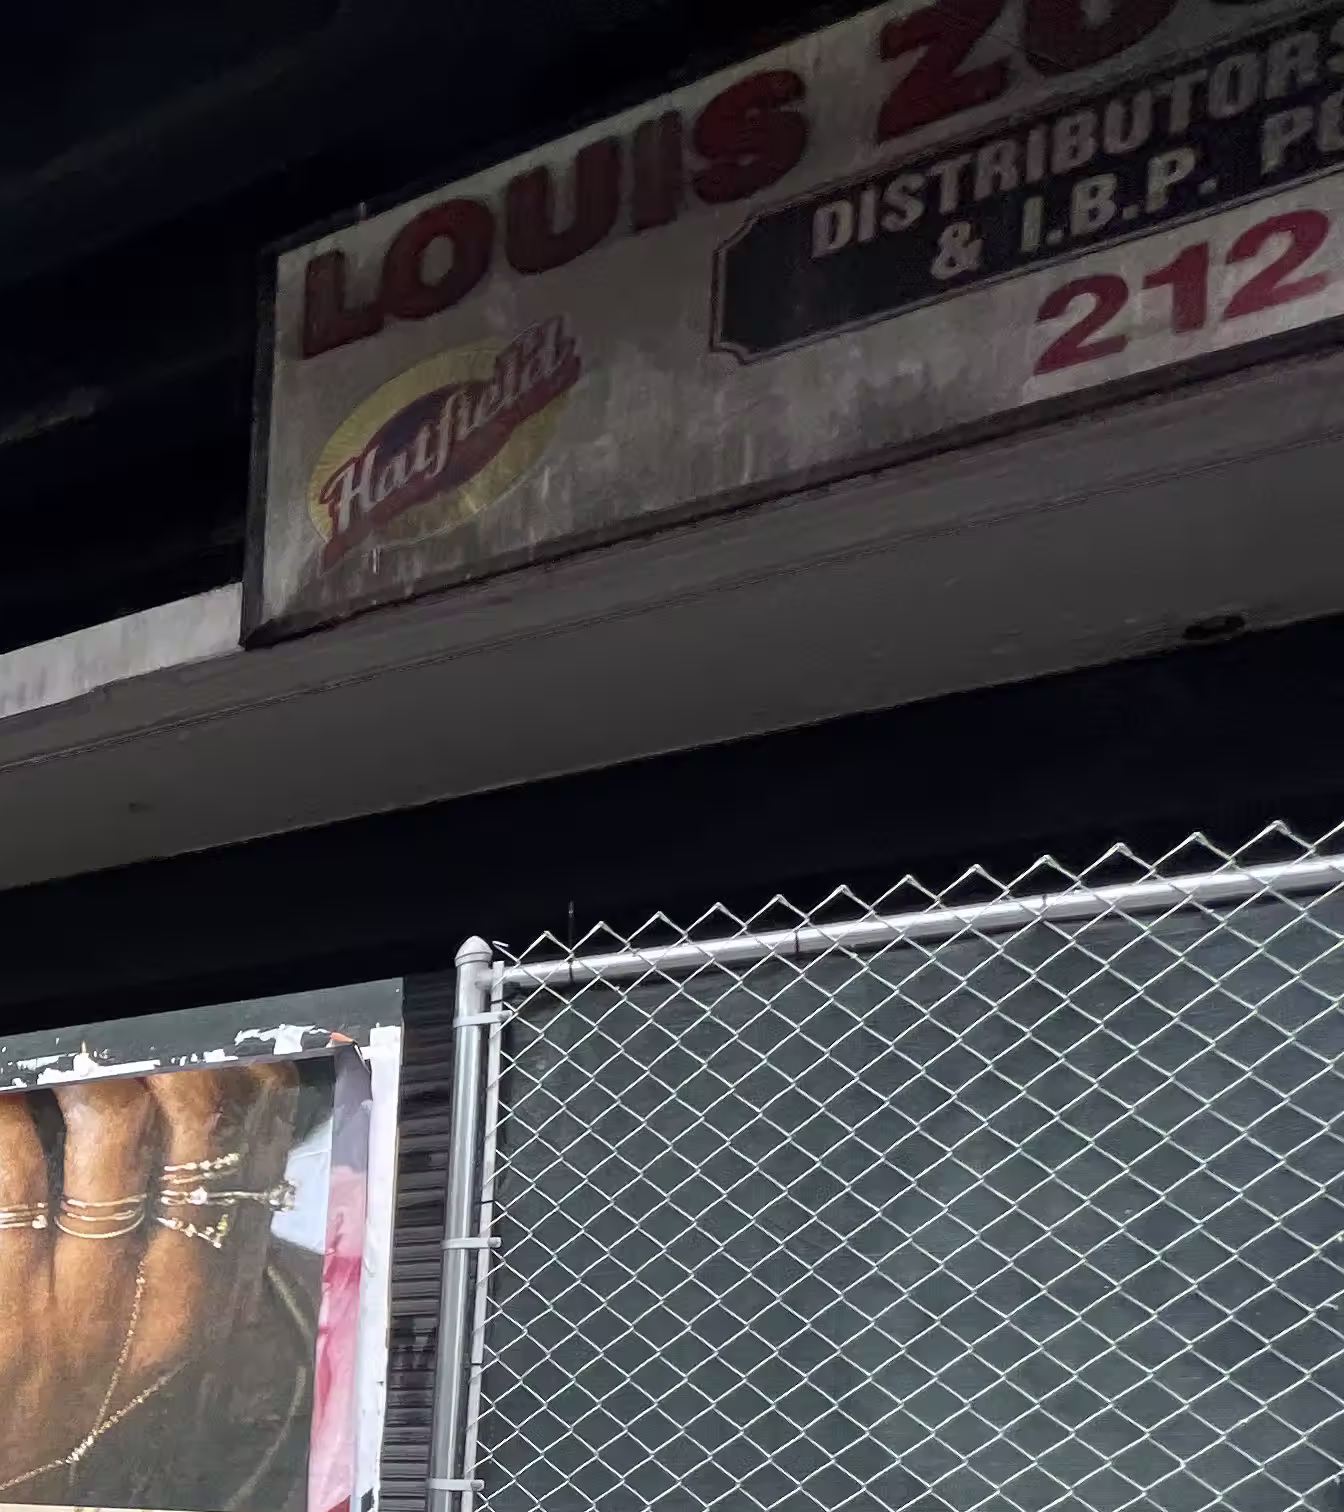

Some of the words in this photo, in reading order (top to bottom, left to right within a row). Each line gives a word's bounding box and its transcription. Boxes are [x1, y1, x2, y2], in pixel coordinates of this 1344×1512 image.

[300, 69, 809, 360] LOUIS
[931, 221, 984, 280] &
[1033, 210, 1329, 376] 212
[321, 315, 576, 533] Hatfield
